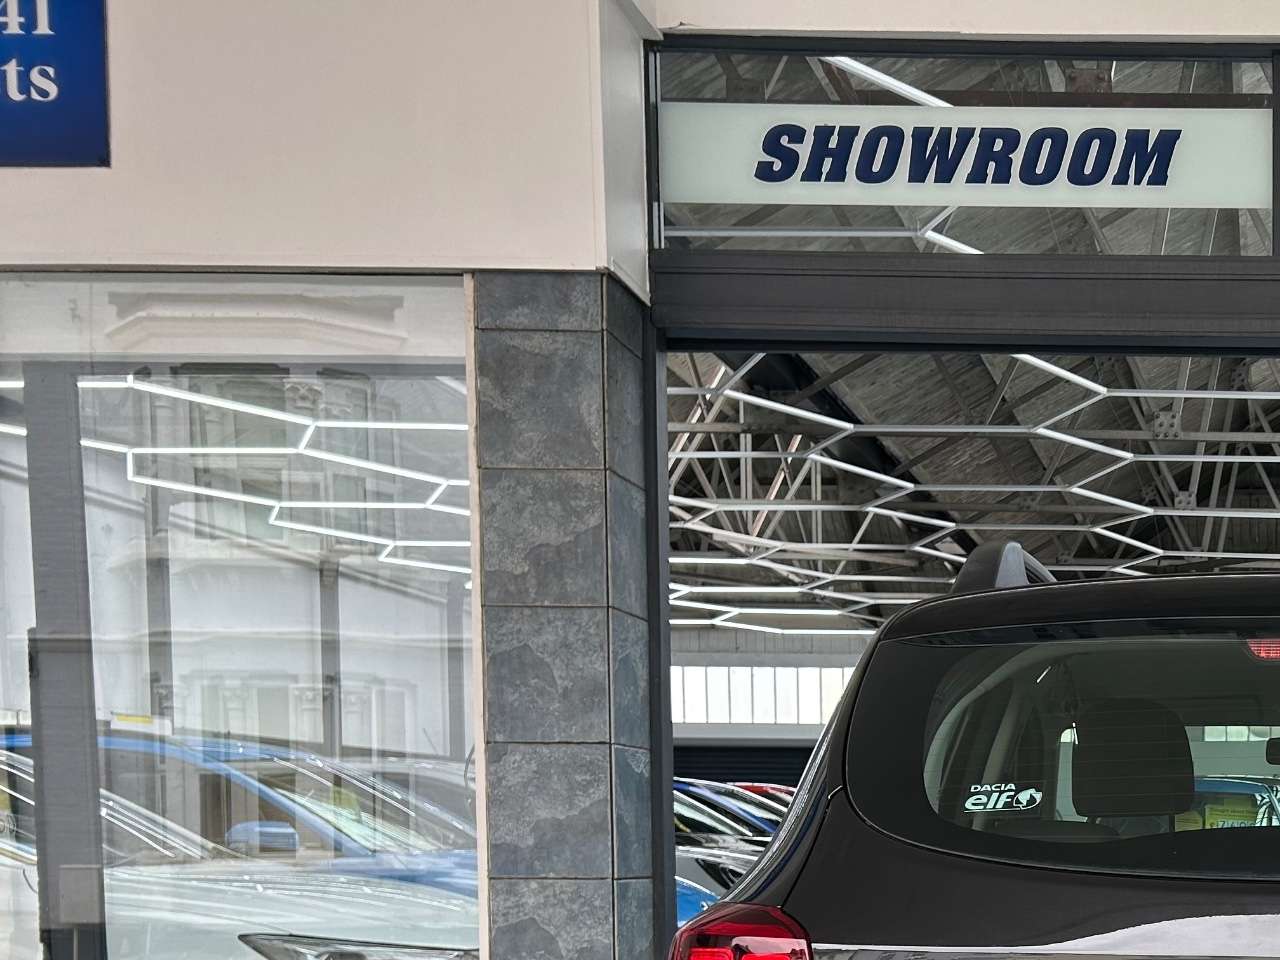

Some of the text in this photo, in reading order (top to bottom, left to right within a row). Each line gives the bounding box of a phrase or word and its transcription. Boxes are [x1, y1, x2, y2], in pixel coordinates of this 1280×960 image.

[0, 58, 58, 102] ts
[753, 123, 1182, 187] SHOWROOM
[964, 791, 1016, 810] elf
[970, 783, 1017, 792] DACIA
